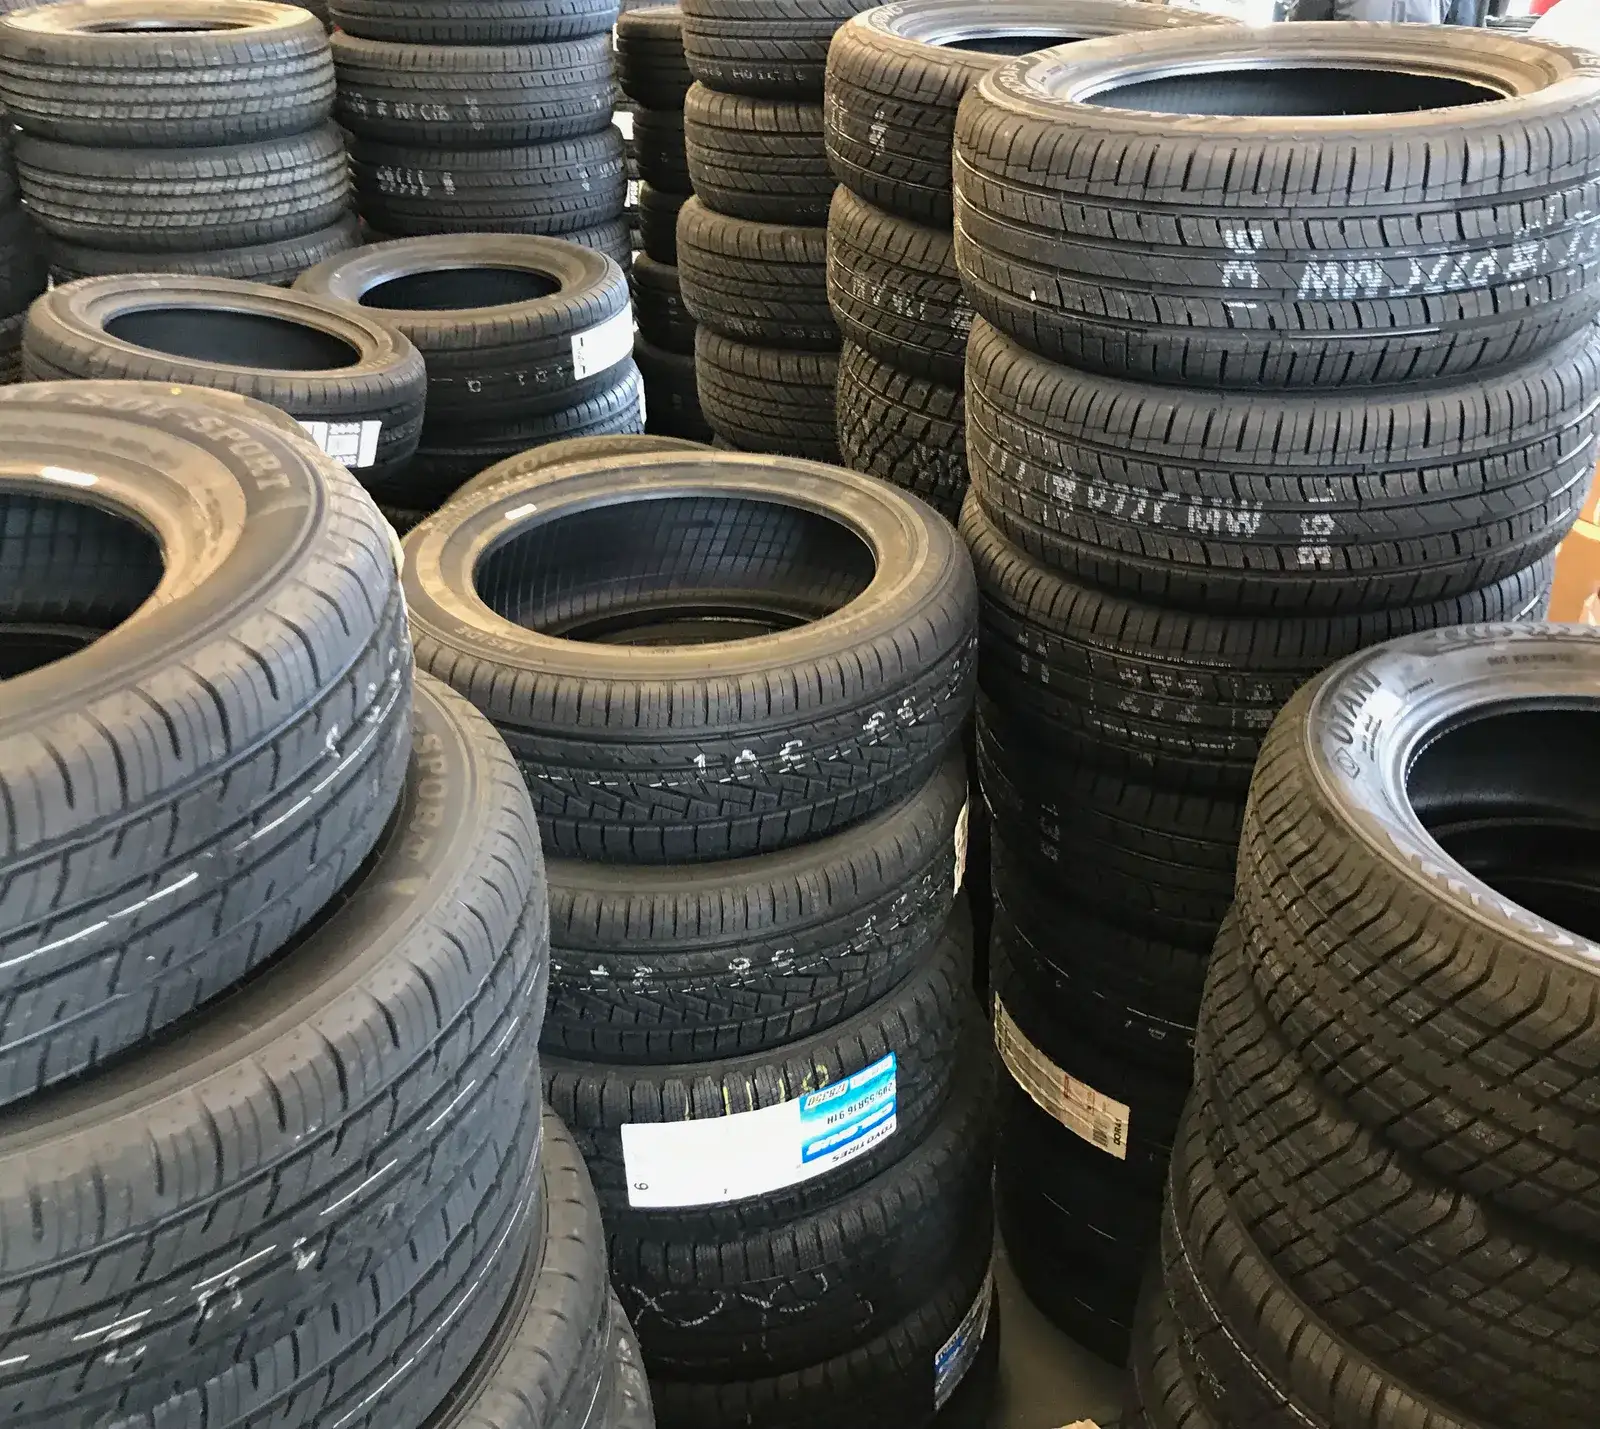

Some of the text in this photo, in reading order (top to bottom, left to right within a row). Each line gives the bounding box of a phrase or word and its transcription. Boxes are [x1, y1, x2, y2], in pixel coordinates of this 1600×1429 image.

[1327, 668, 1382, 745] OTANI
[831, 1123, 893, 1163] TOYO TIRES
